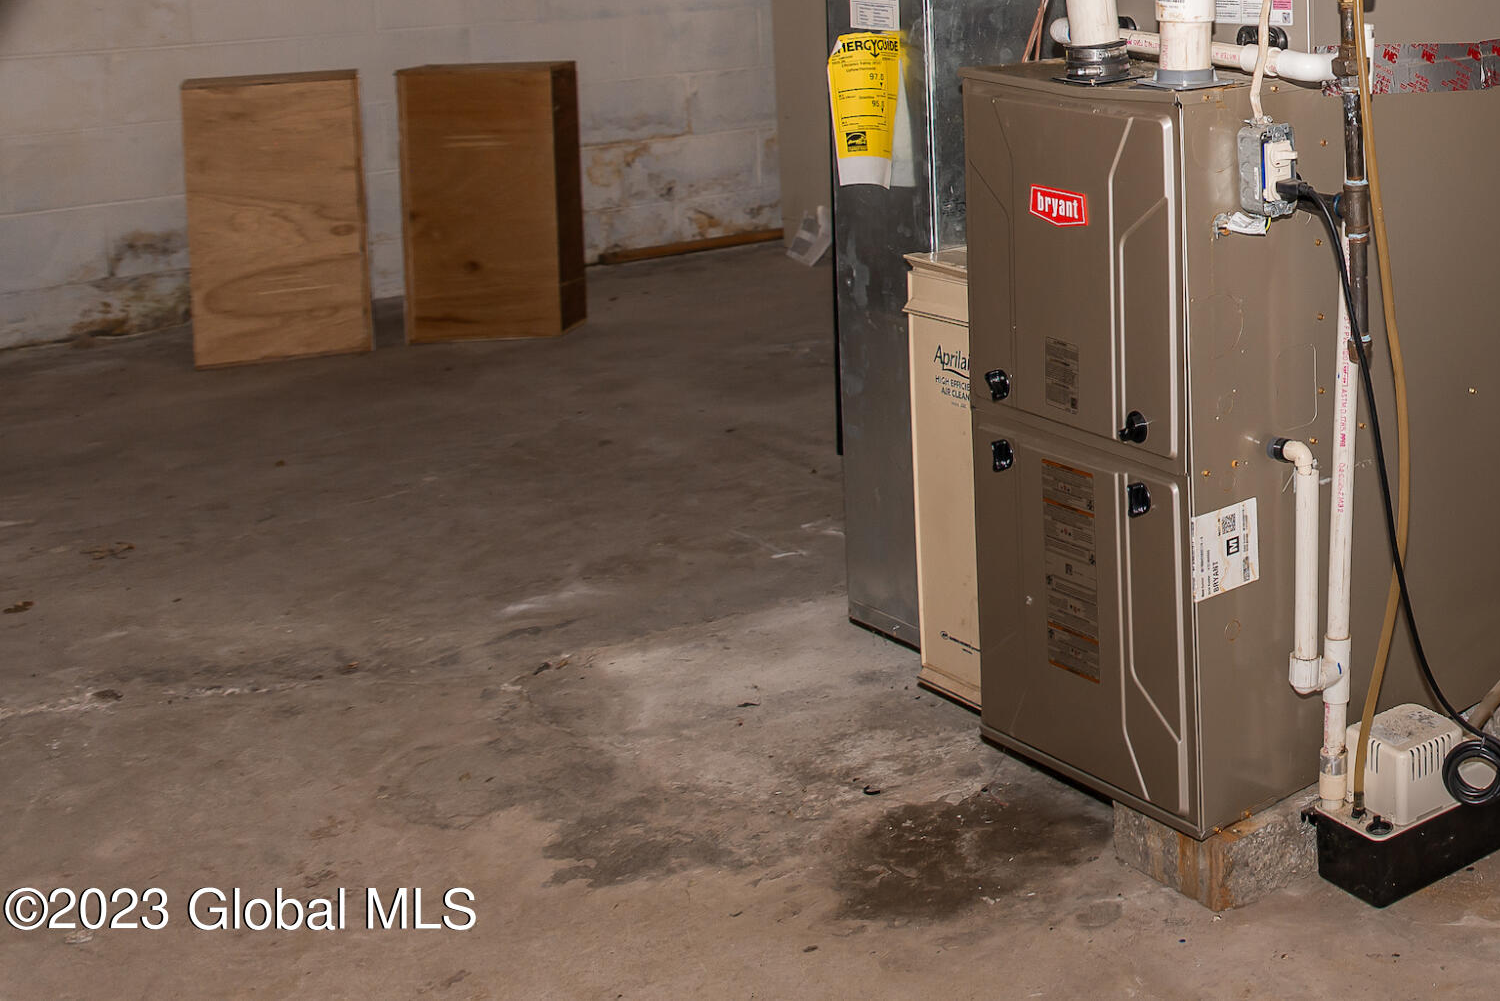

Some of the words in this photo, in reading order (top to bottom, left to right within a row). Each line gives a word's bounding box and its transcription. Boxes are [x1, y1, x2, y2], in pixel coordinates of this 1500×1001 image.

[834, 39, 899, 55] NERGYGUIDE
[1037, 191, 1079, 219] bryant
[934, 344, 970, 370] Aprilai
[935, 374, 950, 385] HIGH
[951, 379, 970, 391] EFFICIE
[941, 386, 951, 396] AIR
[952, 389, 970, 401] CLEAN
